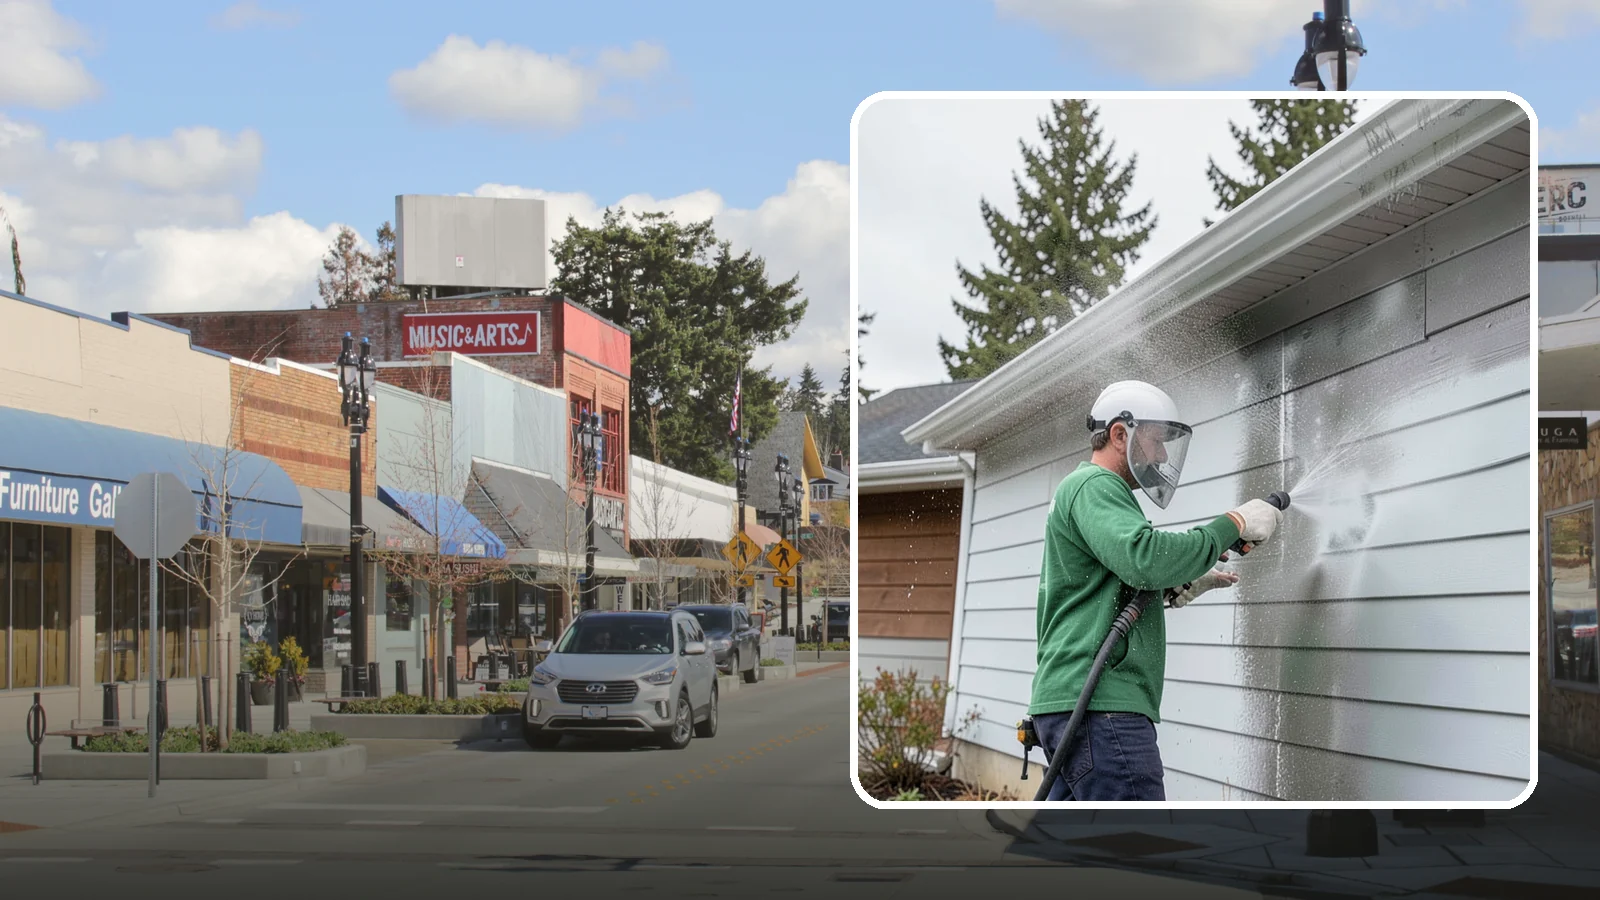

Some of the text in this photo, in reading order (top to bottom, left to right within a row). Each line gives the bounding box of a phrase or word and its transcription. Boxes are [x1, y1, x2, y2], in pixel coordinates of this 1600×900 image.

[408, 322, 519, 349] MUSIC&ARTS
[1540, 427, 1577, 436] UGA
[0, 471, 79, 515] Furniture
[453, 563, 479, 575] SUSHI
